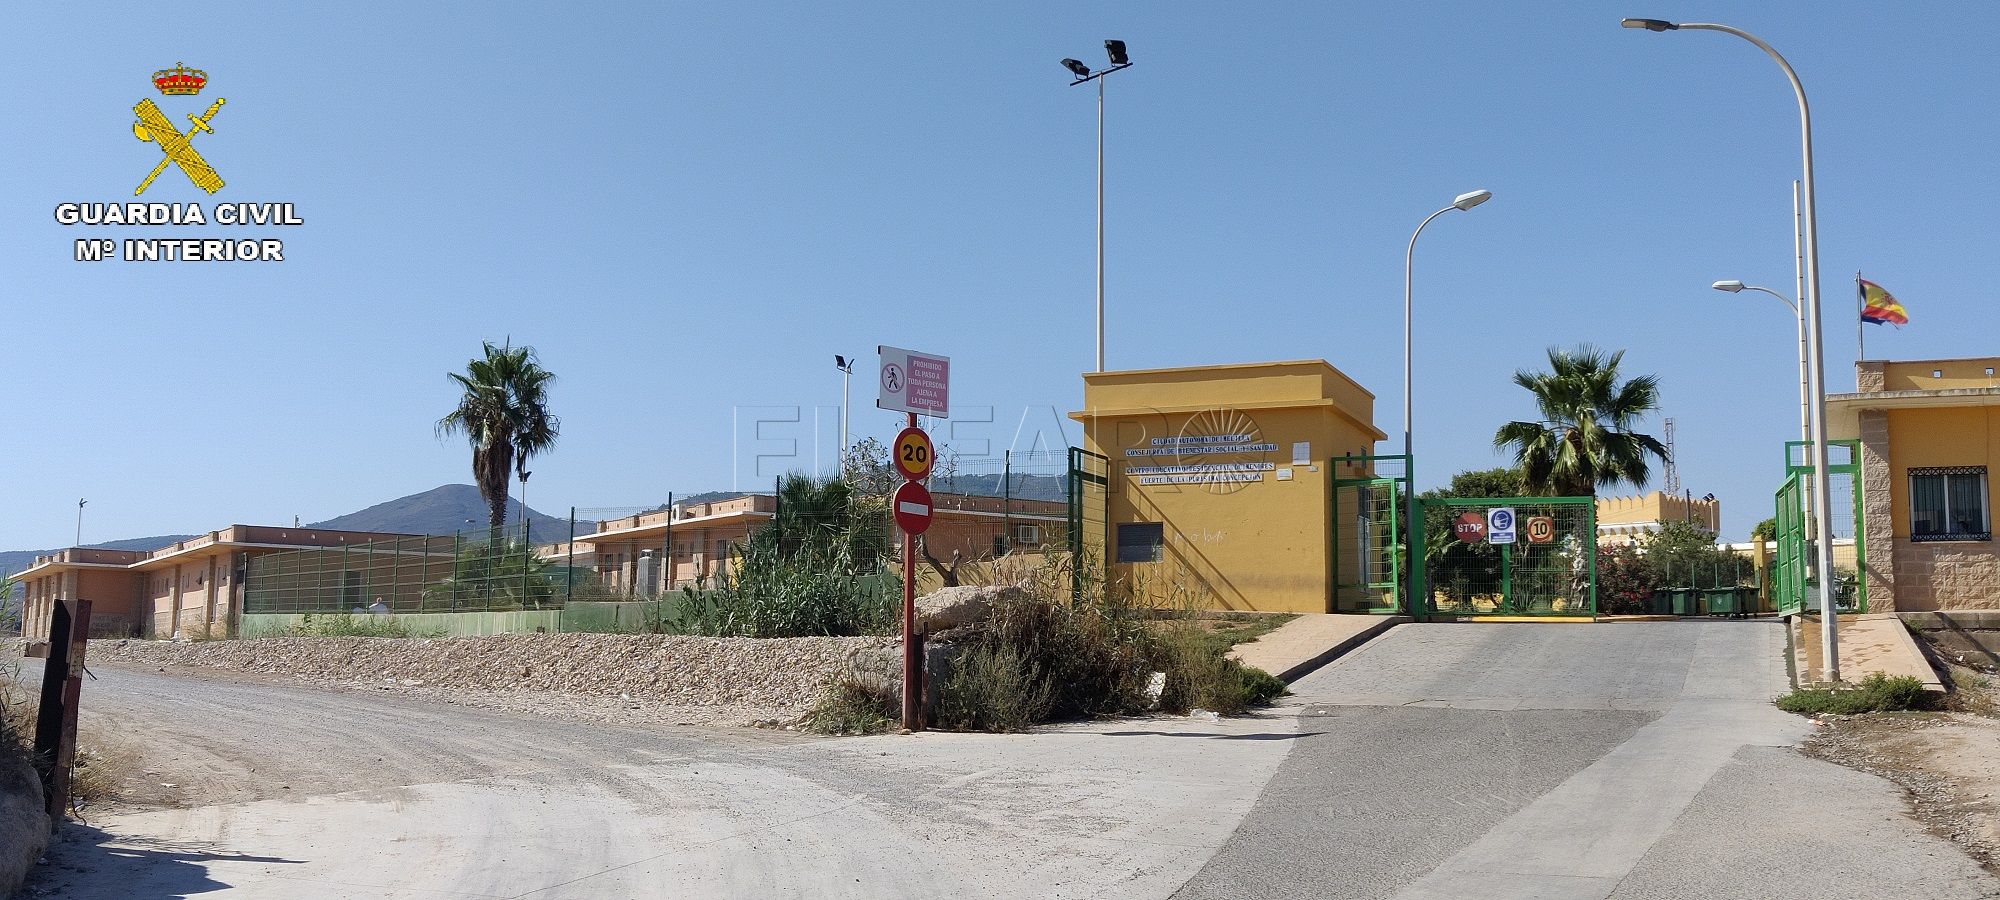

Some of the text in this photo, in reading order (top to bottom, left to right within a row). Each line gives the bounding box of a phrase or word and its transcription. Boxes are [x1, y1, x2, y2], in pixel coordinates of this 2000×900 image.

[913, 360, 942, 370] PROHIBIDO
[921, 370, 935, 379] PASO
[908, 378, 946, 390] TODA PERSONA
[917, 389, 932, 397] AJENA
[911, 396, 943, 408] LA EMPRESA
[903, 444, 927, 463] 20
[1178, 446, 1211, 454] BIENESTAR
[1458, 524, 1482, 533] STOP
[1534, 523, 1547, 535] 10
